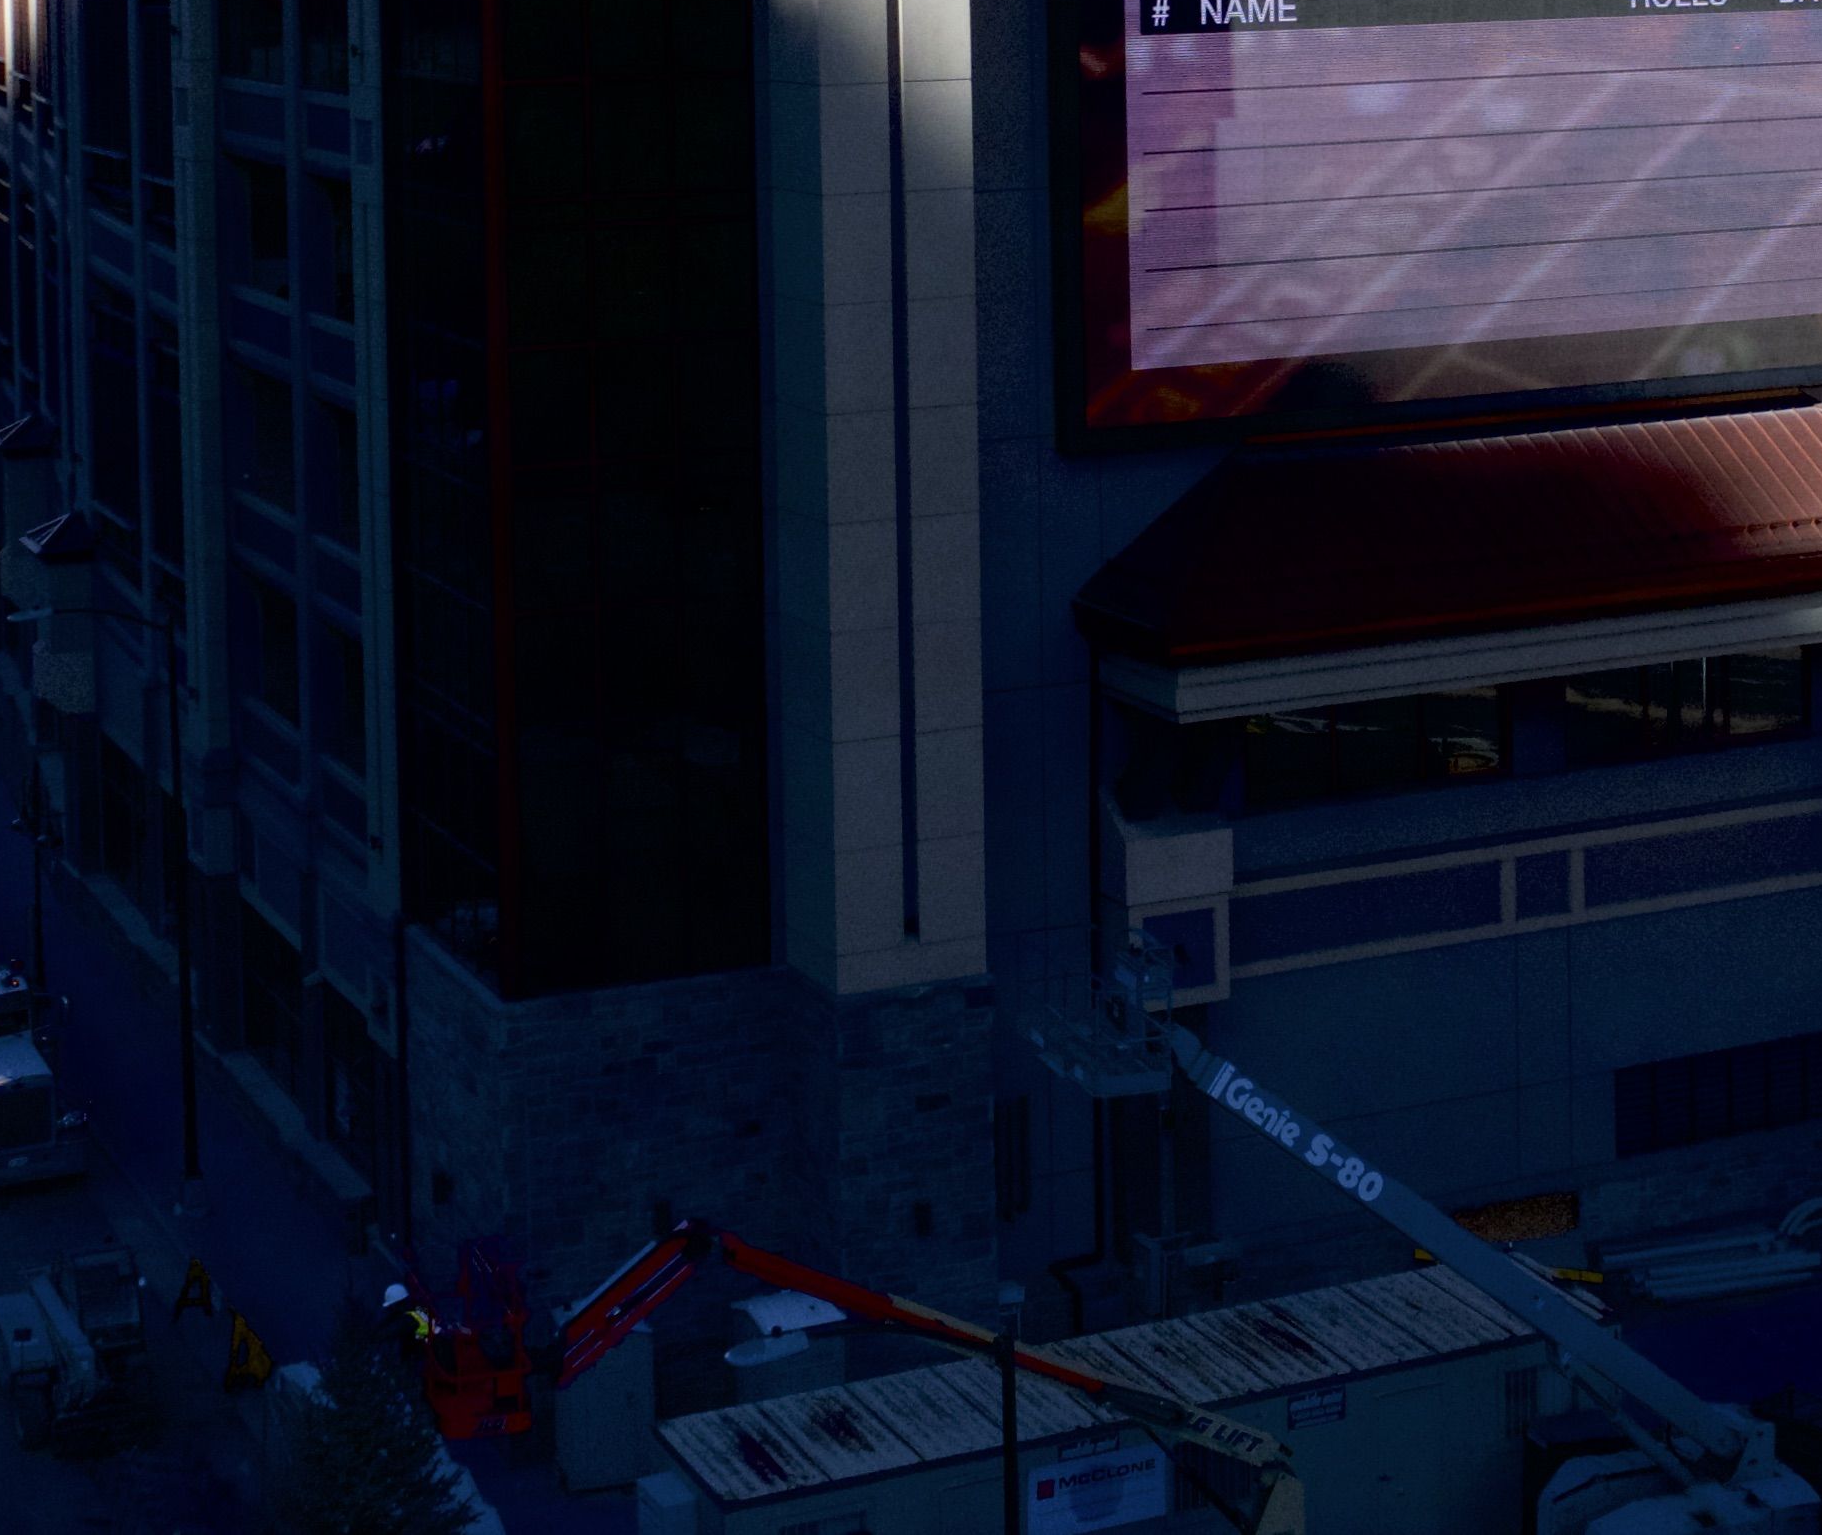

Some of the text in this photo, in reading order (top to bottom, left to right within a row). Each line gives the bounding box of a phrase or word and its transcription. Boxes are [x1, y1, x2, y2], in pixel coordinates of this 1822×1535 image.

[1226, 1077, 1385, 1203] Genie S-80
[1211, 1423, 1265, 1454] LIFT
